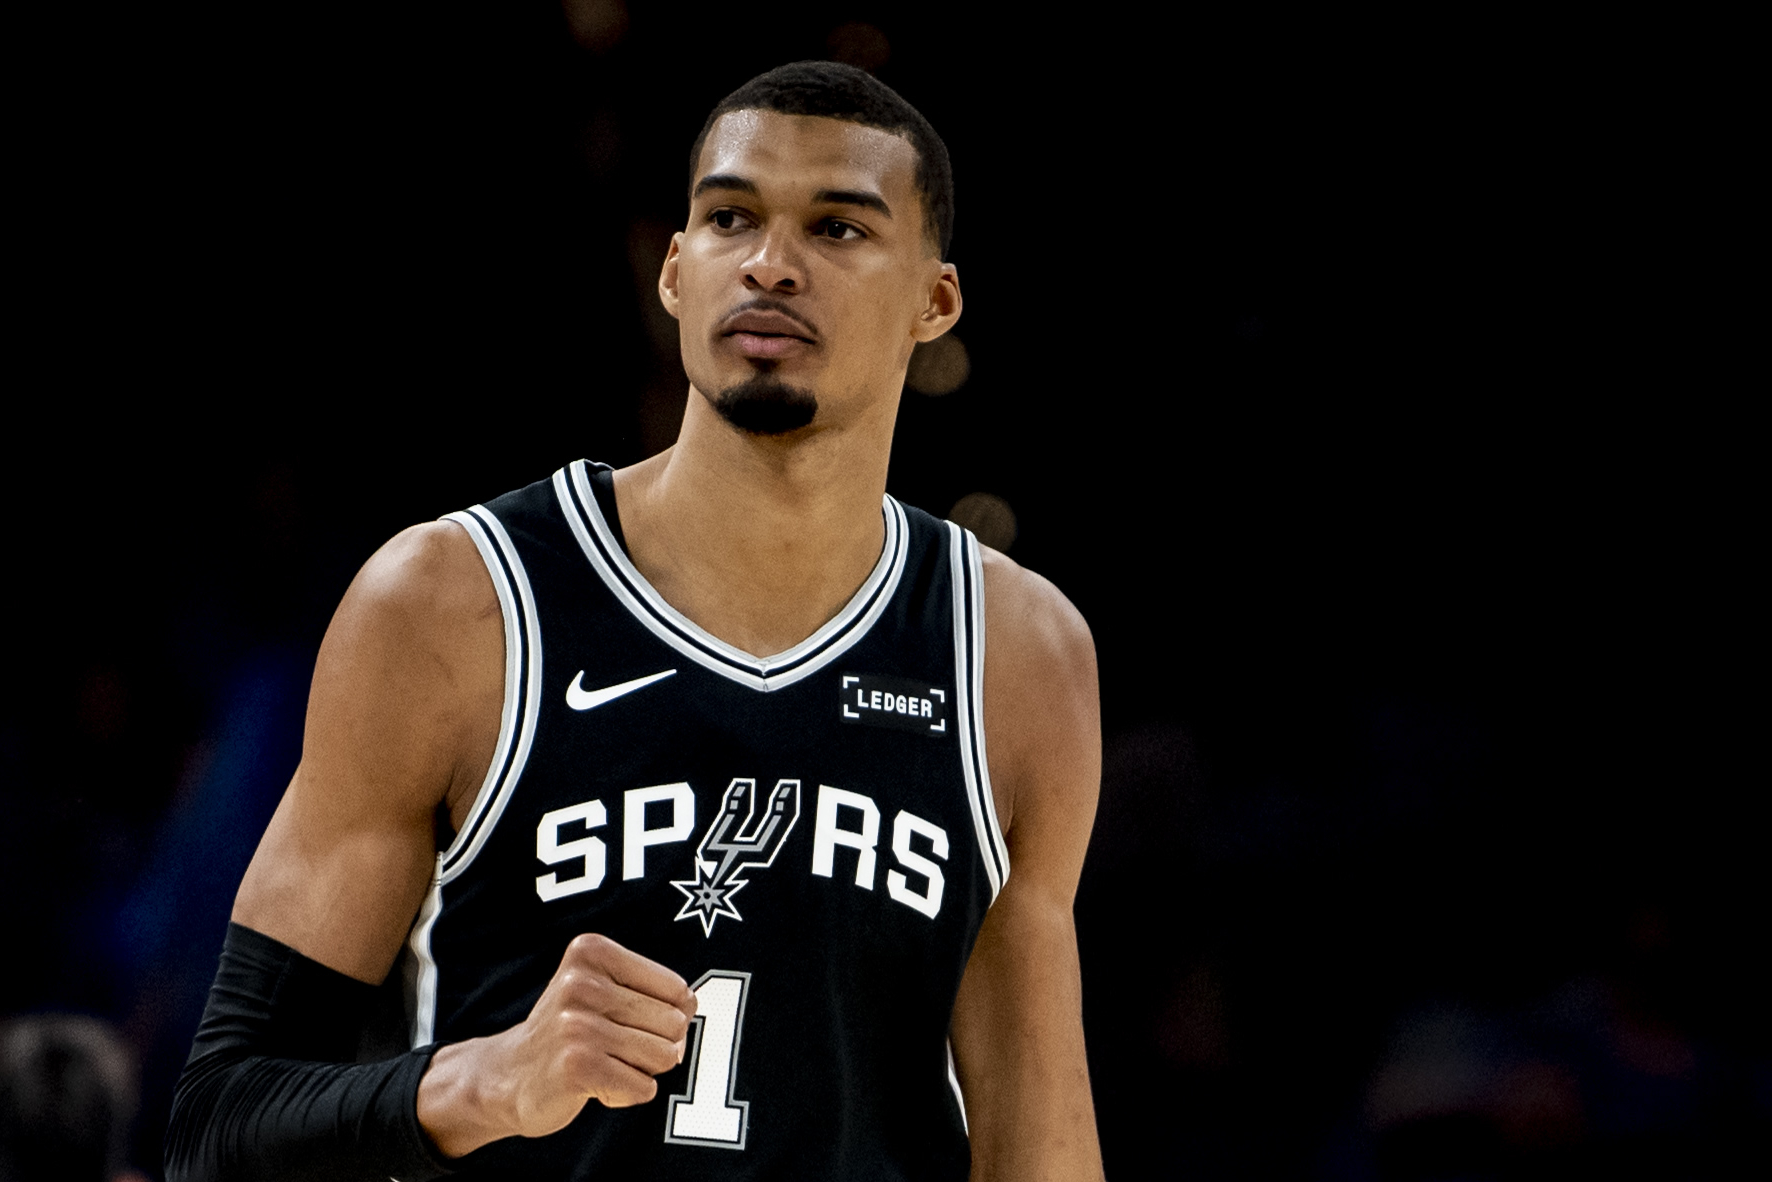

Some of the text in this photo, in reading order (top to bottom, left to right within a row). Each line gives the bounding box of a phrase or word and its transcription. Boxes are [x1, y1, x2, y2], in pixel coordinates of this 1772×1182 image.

[857, 688, 932, 718] LEDGER
[536, 778, 949, 938] SPURS
[664, 969, 752, 1150] 1
